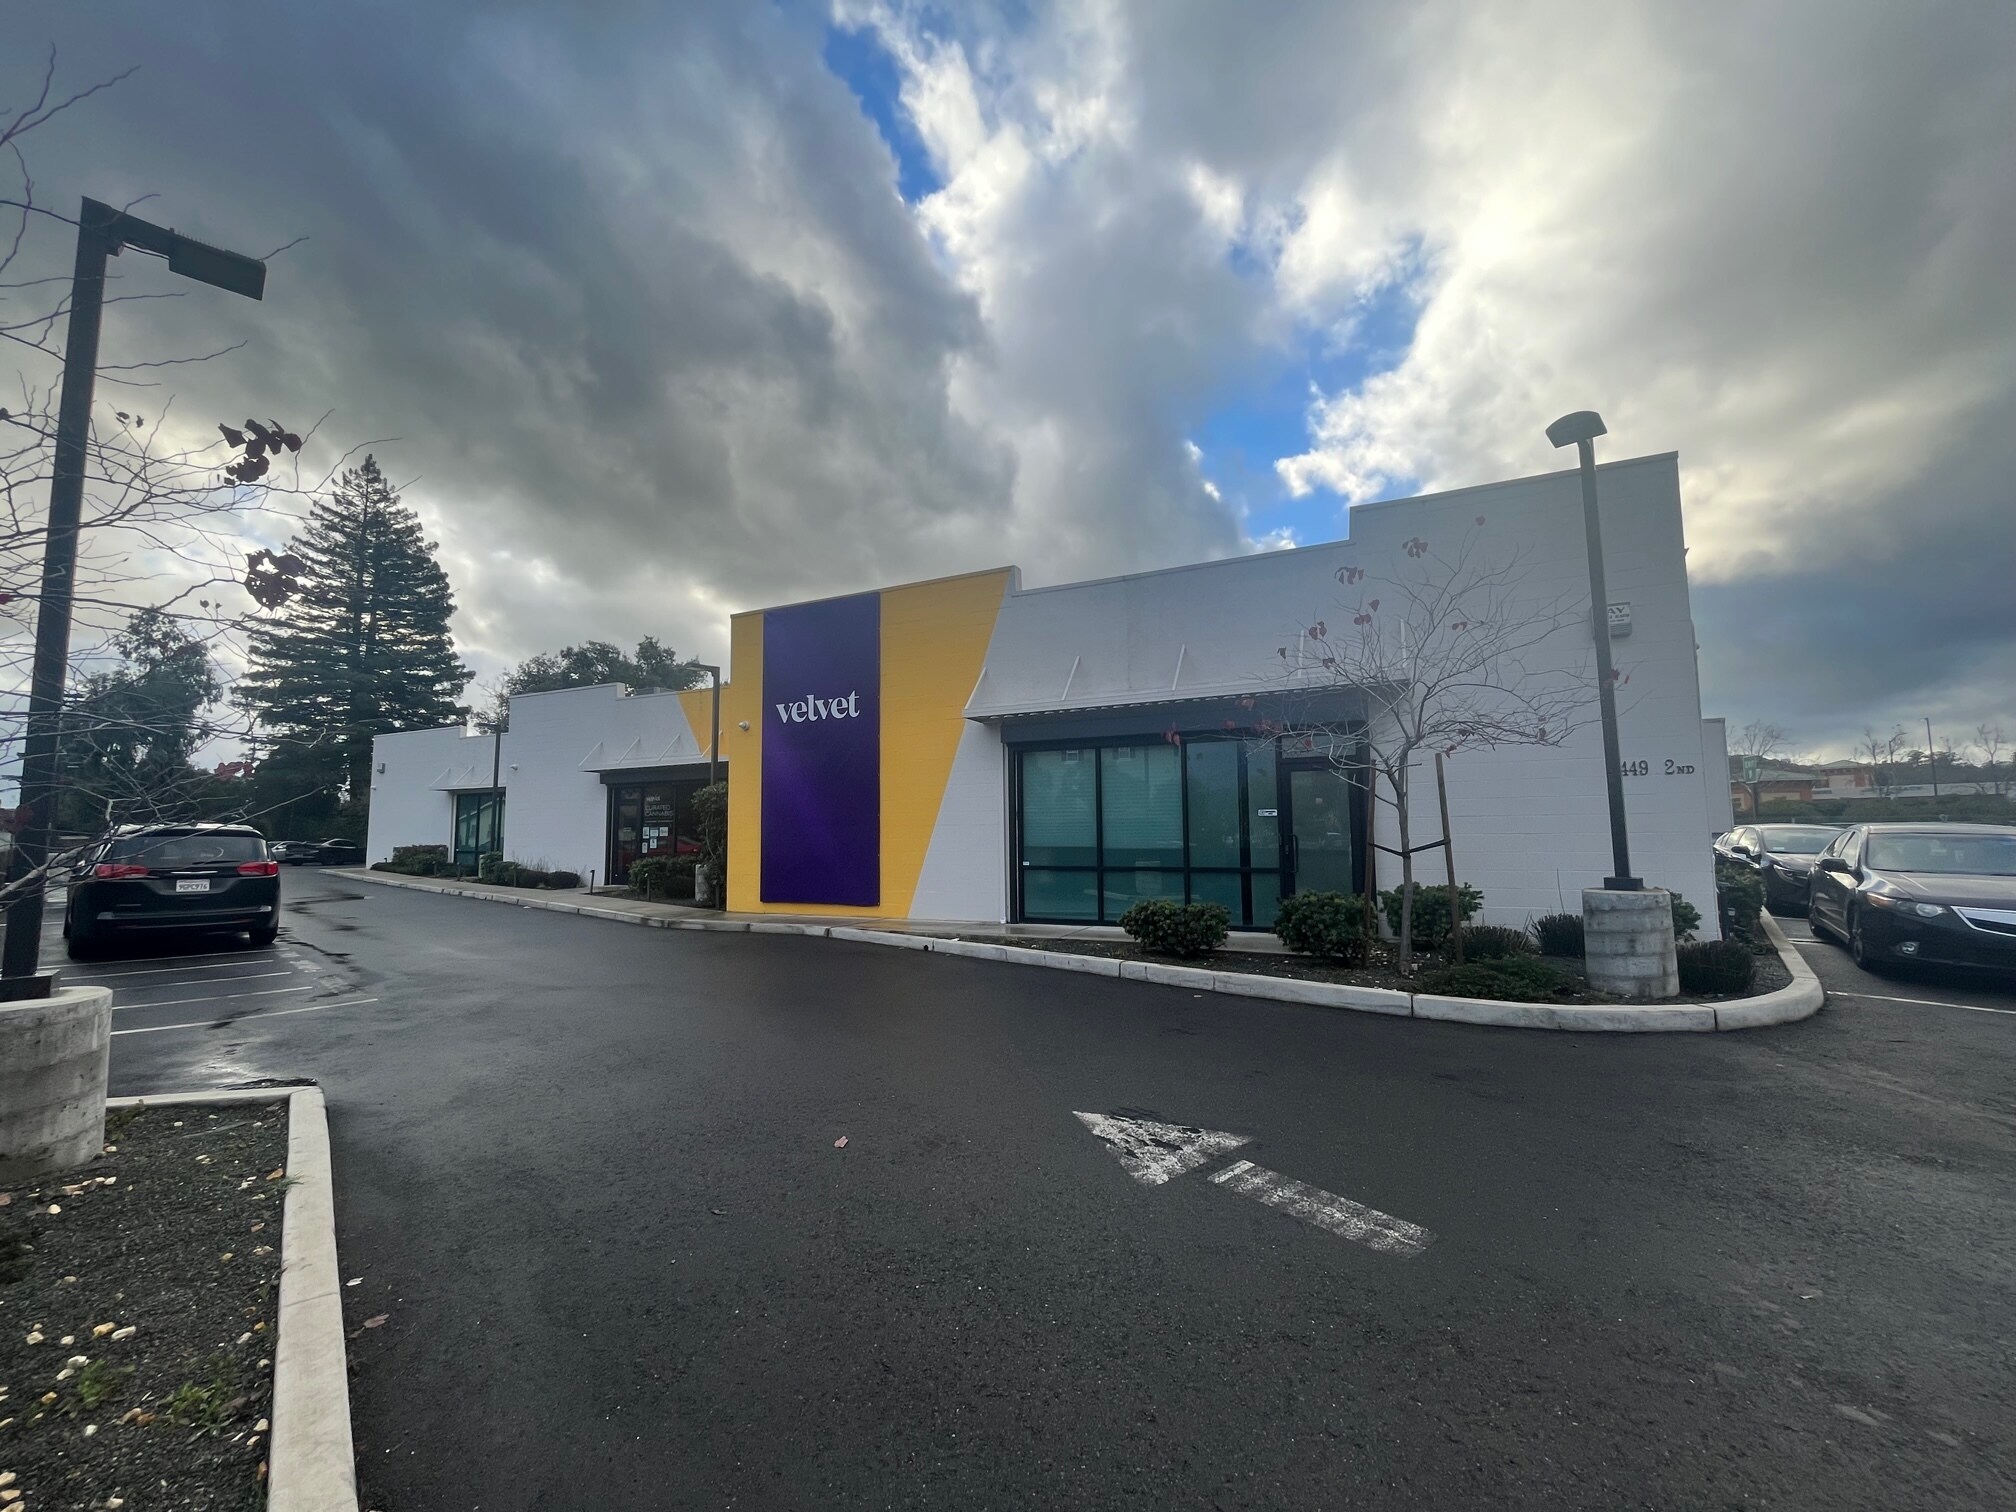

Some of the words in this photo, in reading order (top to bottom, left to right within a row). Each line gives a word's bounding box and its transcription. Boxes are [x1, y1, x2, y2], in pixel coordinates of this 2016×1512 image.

[1607, 606, 1625, 614] AY
[776, 690, 860, 723] velvet
[1664, 759, 1695, 775] 2ND
